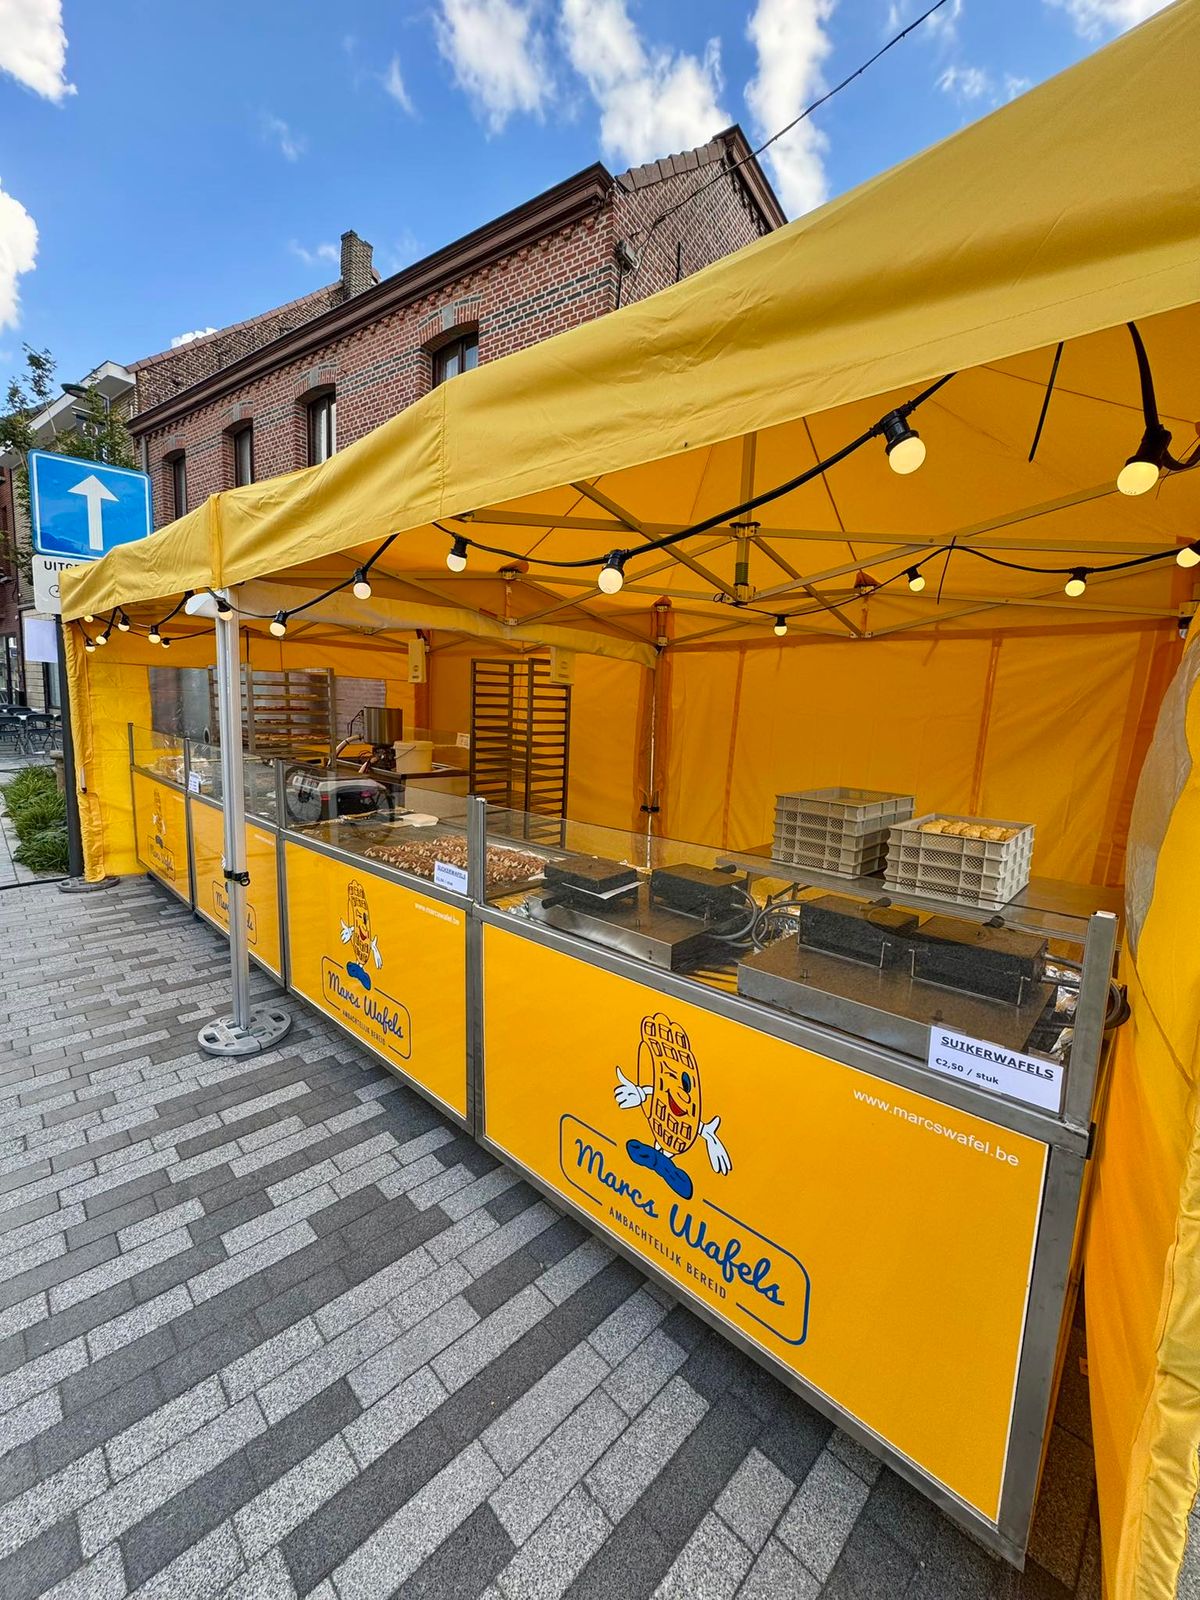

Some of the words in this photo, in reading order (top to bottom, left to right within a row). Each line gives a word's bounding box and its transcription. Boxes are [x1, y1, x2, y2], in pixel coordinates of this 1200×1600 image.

[328, 970, 360, 1008] Marcs
[364, 995, 404, 1038] Wafels
[940, 1035, 1055, 1081] SUIKERWAFELS
[975, 1072, 999, 1085] stuk
[853, 1088, 1020, 1167] www.marcswafel.be
[575, 1137, 659, 1219] Marcs
[669, 1203, 786, 1306] Wafels
[608, 1206, 682, 1268] AMBACHTELIJK
[686, 1261, 728, 1300] BEREID
